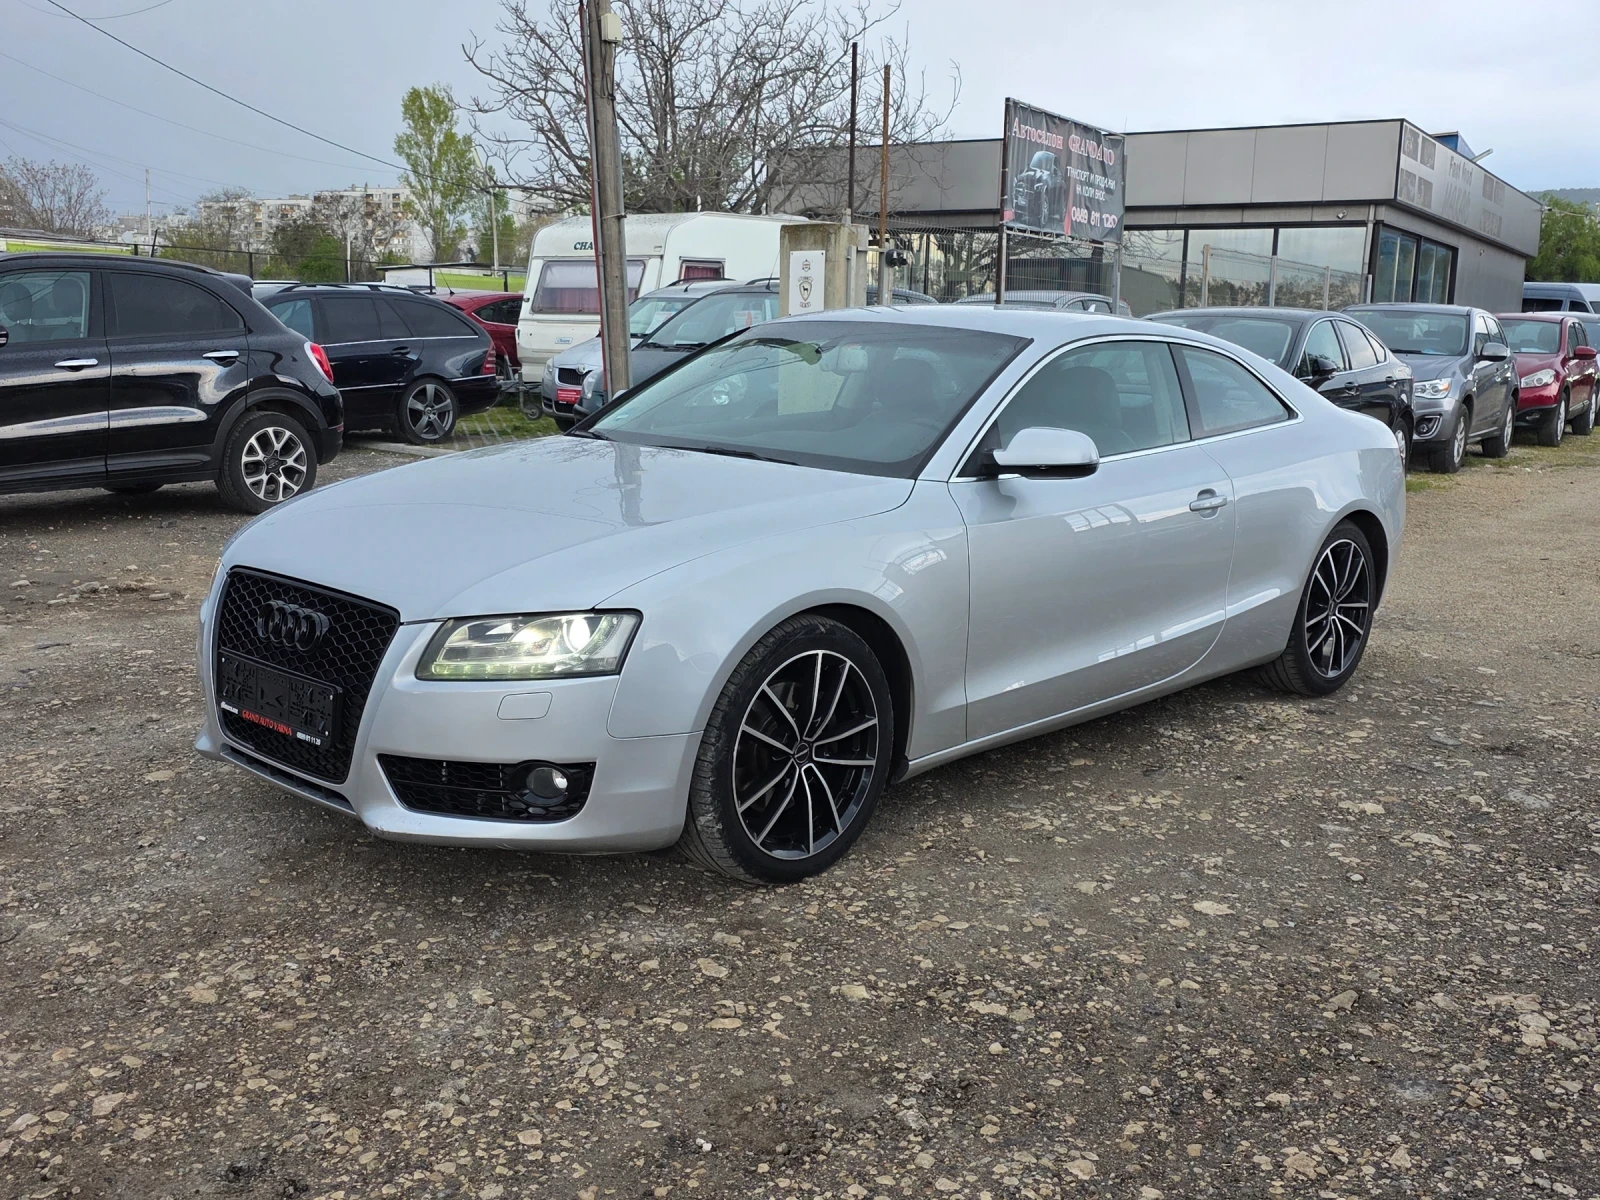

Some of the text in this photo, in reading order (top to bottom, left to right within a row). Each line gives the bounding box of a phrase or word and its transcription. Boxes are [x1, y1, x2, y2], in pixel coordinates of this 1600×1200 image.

[1102, 213, 1118, 229] 120
[242, 710, 292, 736] GRAND AUTO VARNA
